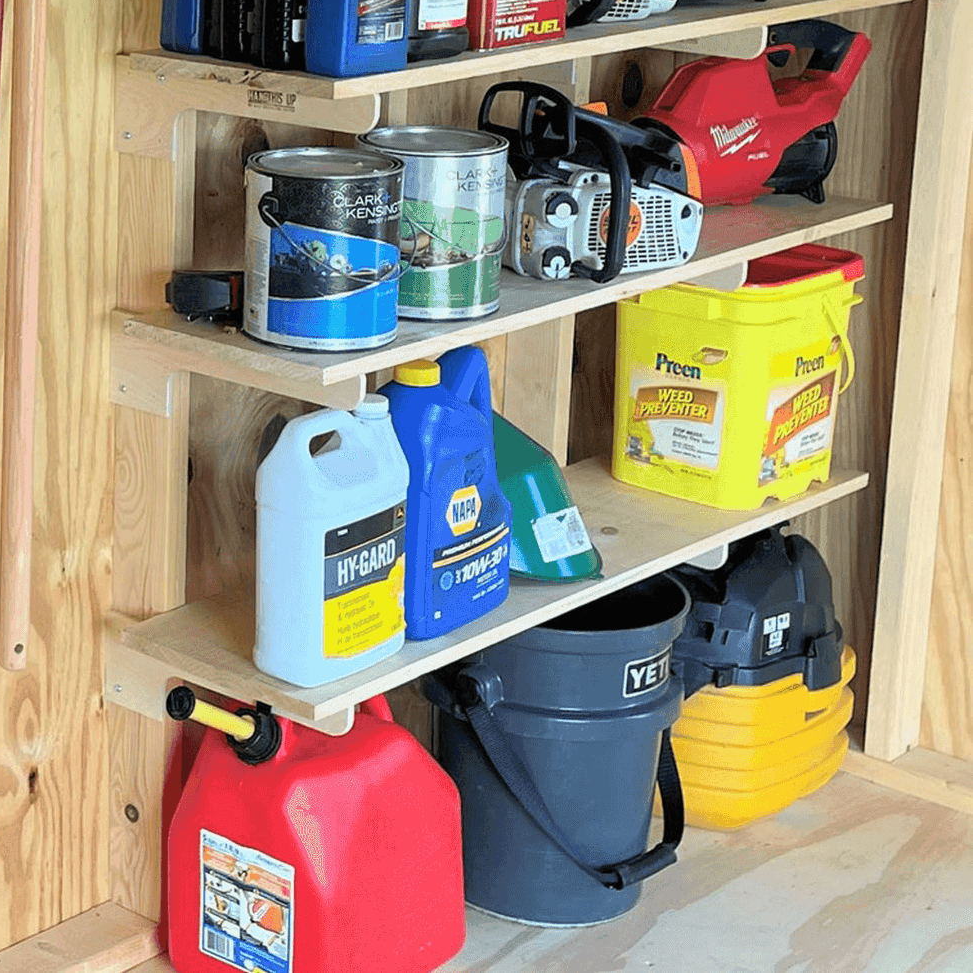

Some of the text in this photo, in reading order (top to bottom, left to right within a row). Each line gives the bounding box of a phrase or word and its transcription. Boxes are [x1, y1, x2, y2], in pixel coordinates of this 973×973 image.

[494, 19, 561, 41] TRUFUEL
[656, 352, 701, 380] Preen
[795, 356, 824, 377] Preen
[658, 388, 694, 404] WEED
[793, 384, 822, 415] WEED
[638, 401, 709, 419] PREVENTER
[772, 395, 829, 445] PREVENTER
[452, 497, 476, 523] NAPA
[337, 538, 396, 587] HY-GARD
